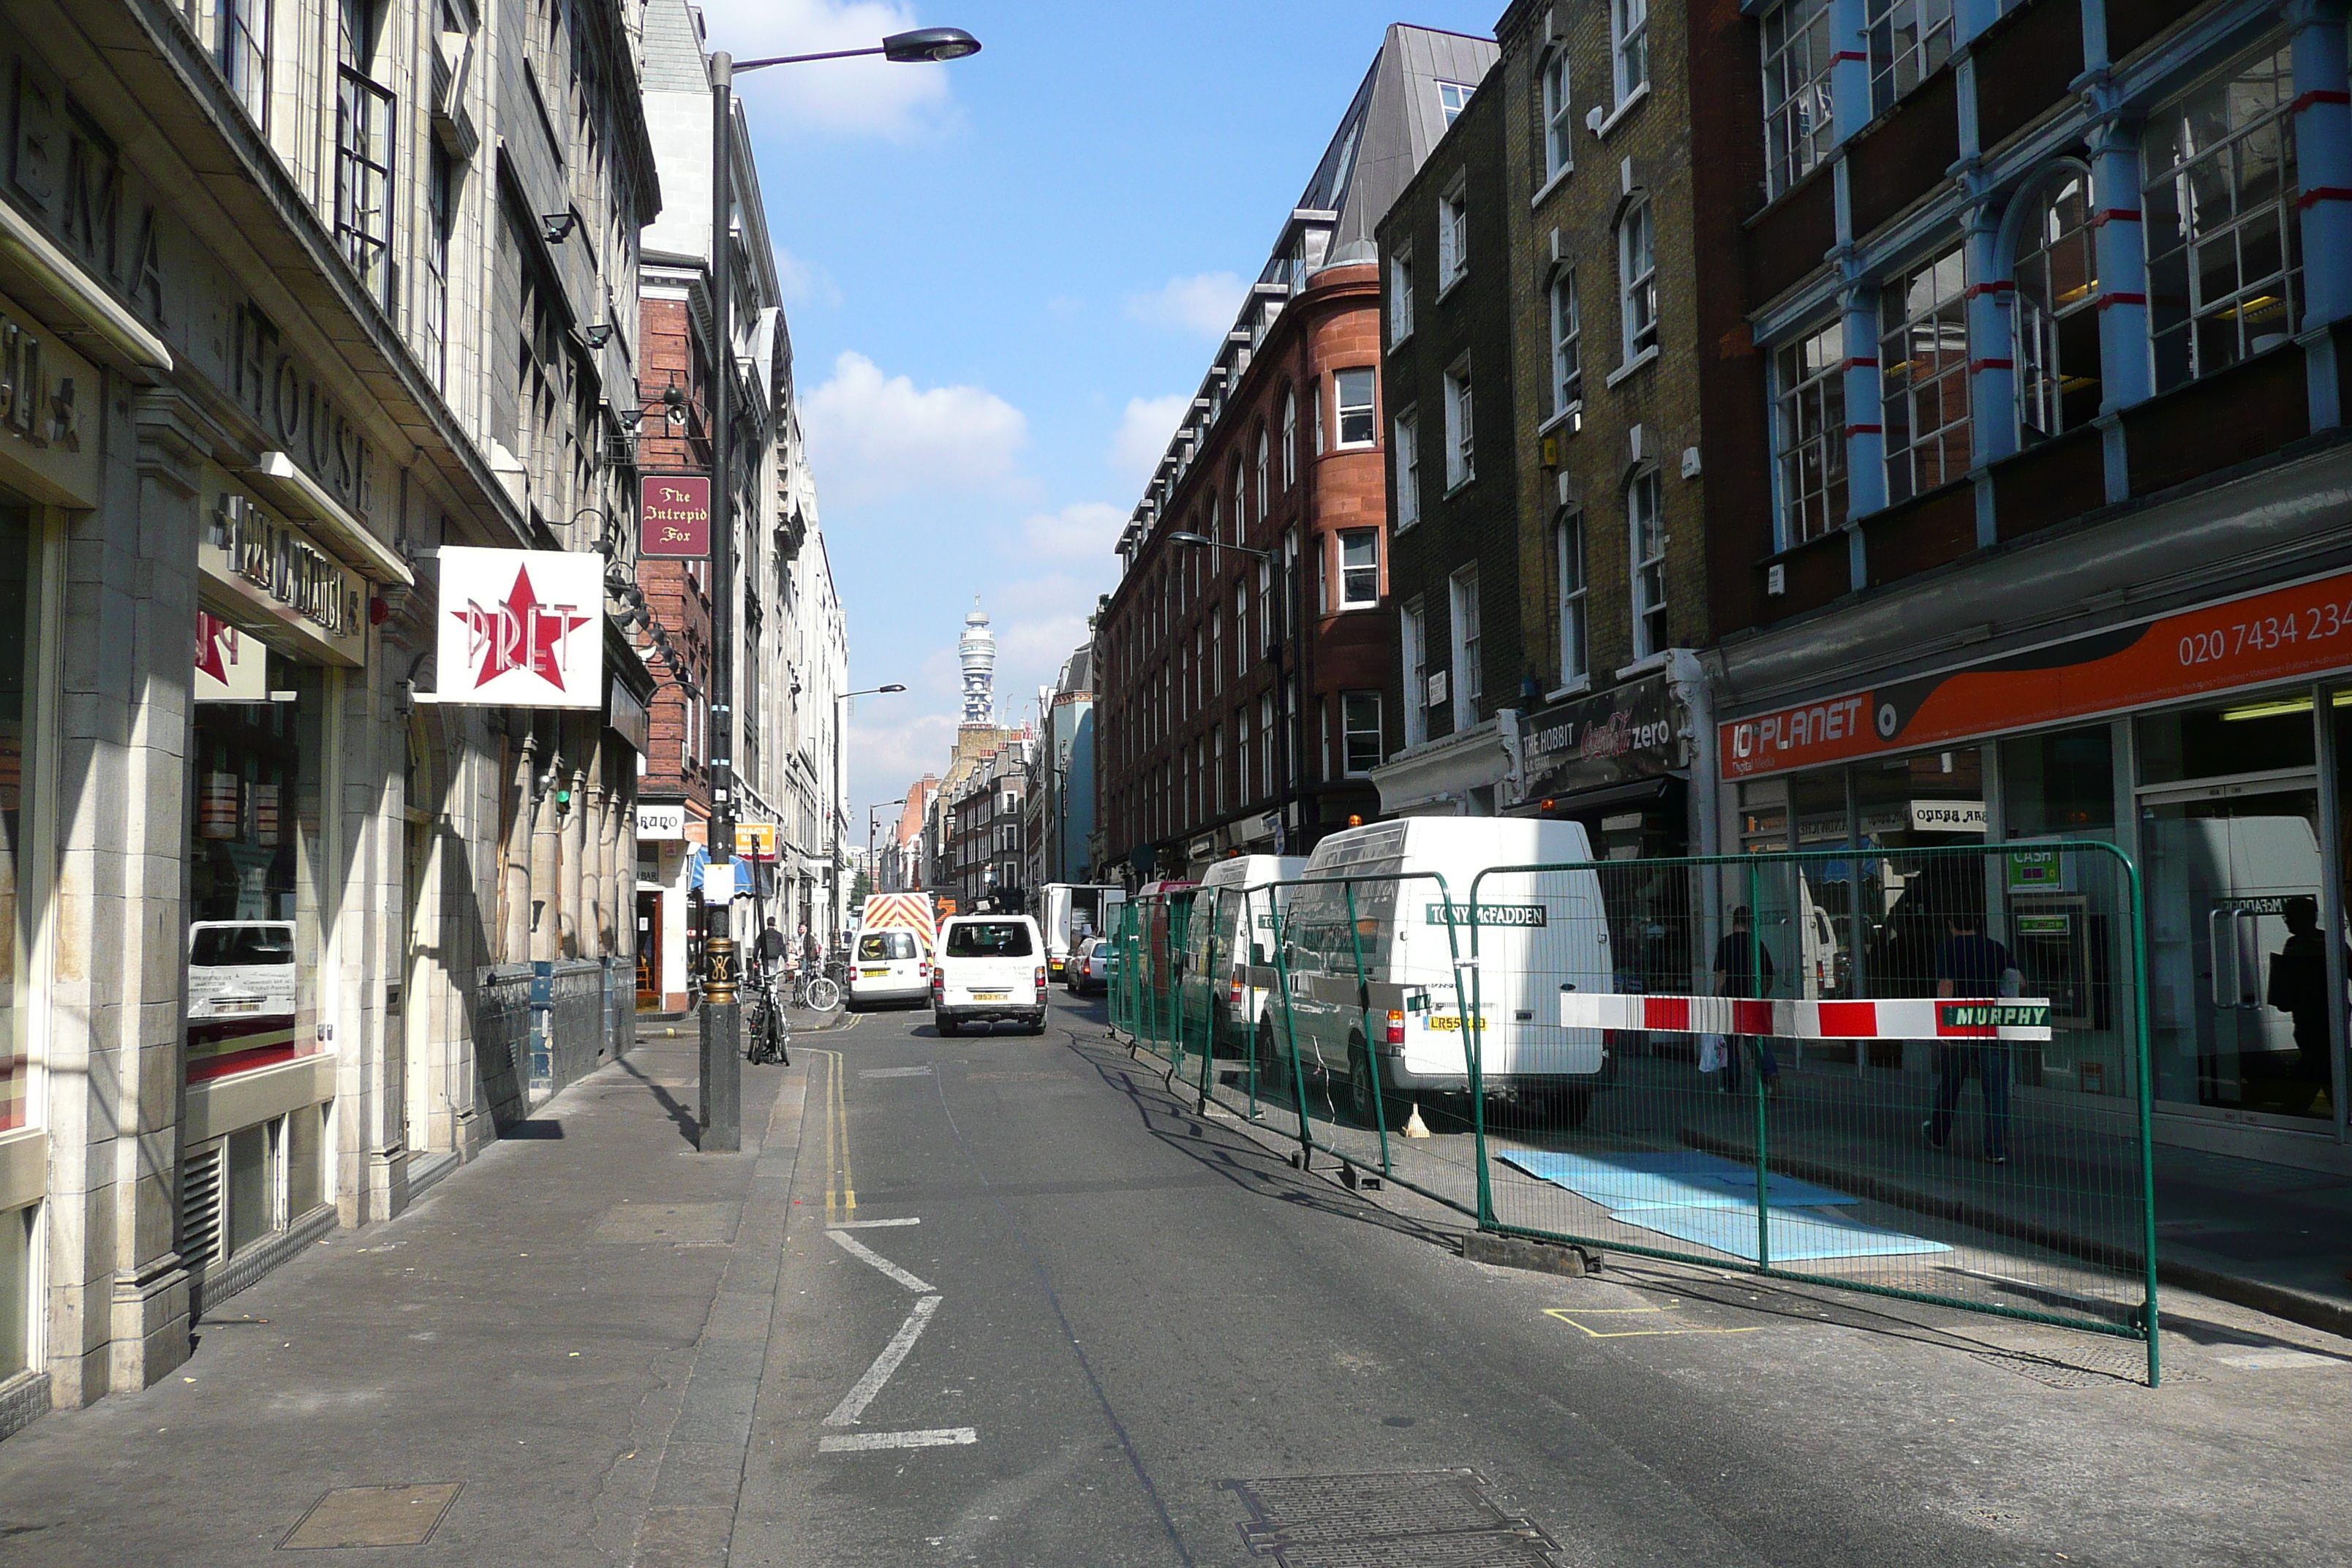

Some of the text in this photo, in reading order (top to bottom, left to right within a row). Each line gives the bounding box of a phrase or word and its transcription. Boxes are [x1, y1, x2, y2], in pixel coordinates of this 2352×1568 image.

[235, 301, 374, 524] HOUSE
[659, 487, 691, 504] The
[644, 505, 707, 524] Intrepid
[659, 527, 691, 545] Fox
[467, 598, 578, 671] PRET
[2179, 630, 2225, 666] 020
[2231, 612, 2298, 655] 7434
[2182, 679, 2213, 690] Packaging
[2249, 666, 2281, 678] Mastering
[1760, 698, 1862, 754] PLANET
[1523, 733, 1539, 758] THE
[1541, 723, 1574, 753] HOBBIT
[1632, 720, 1669, 750] zero
[1733, 758, 1753, 776] Digital
[637, 816, 677, 830] RUNO
[2013, 851, 2052, 864] CASH
[641, 871, 657, 881] BAR
[1476, 906, 1543, 925] McFADDEN
[1956, 1007, 2047, 1026] MURPHY
